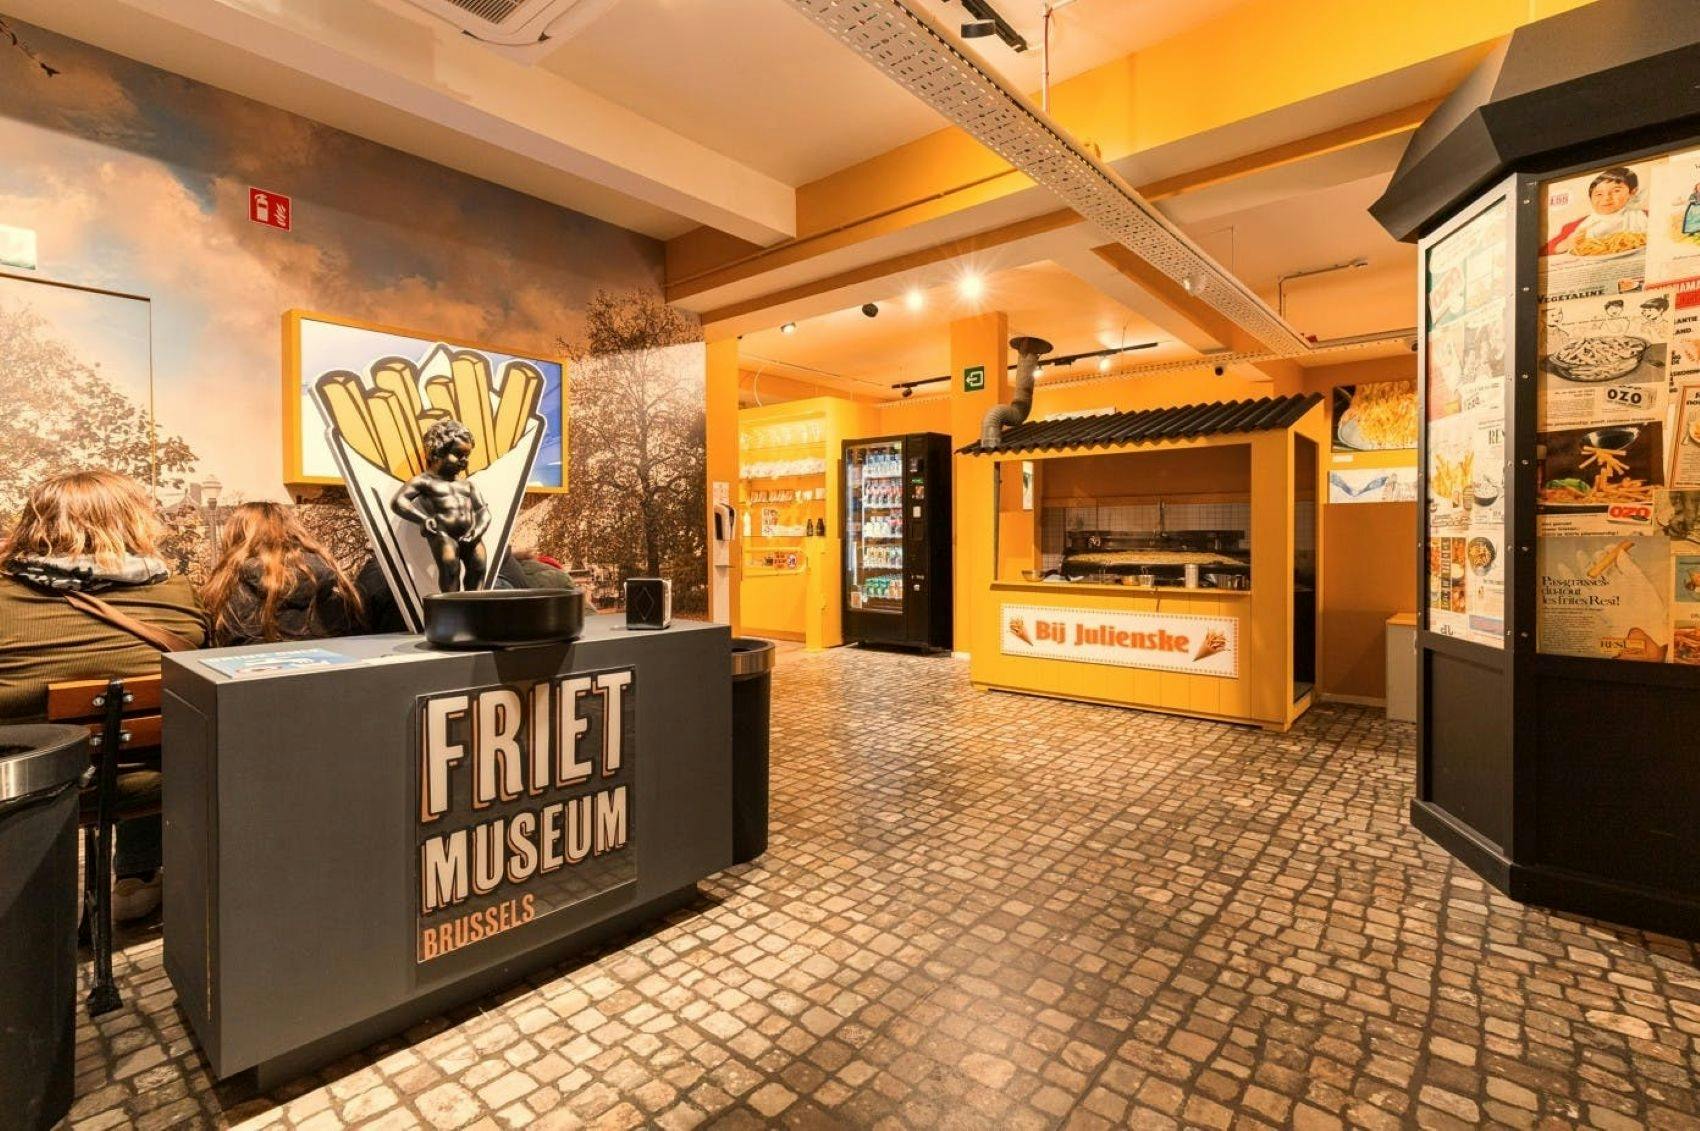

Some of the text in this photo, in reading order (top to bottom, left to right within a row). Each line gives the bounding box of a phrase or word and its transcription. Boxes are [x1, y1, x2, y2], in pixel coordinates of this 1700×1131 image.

[1607, 389, 1642, 404] OZO
[1609, 506, 1651, 519] OZO
[1035, 620, 1190, 653] Bij Julienske
[421, 671, 632, 823] FRIET
[421, 785, 627, 916] MUSEUM
[423, 893, 536, 960] BRUSSELS
